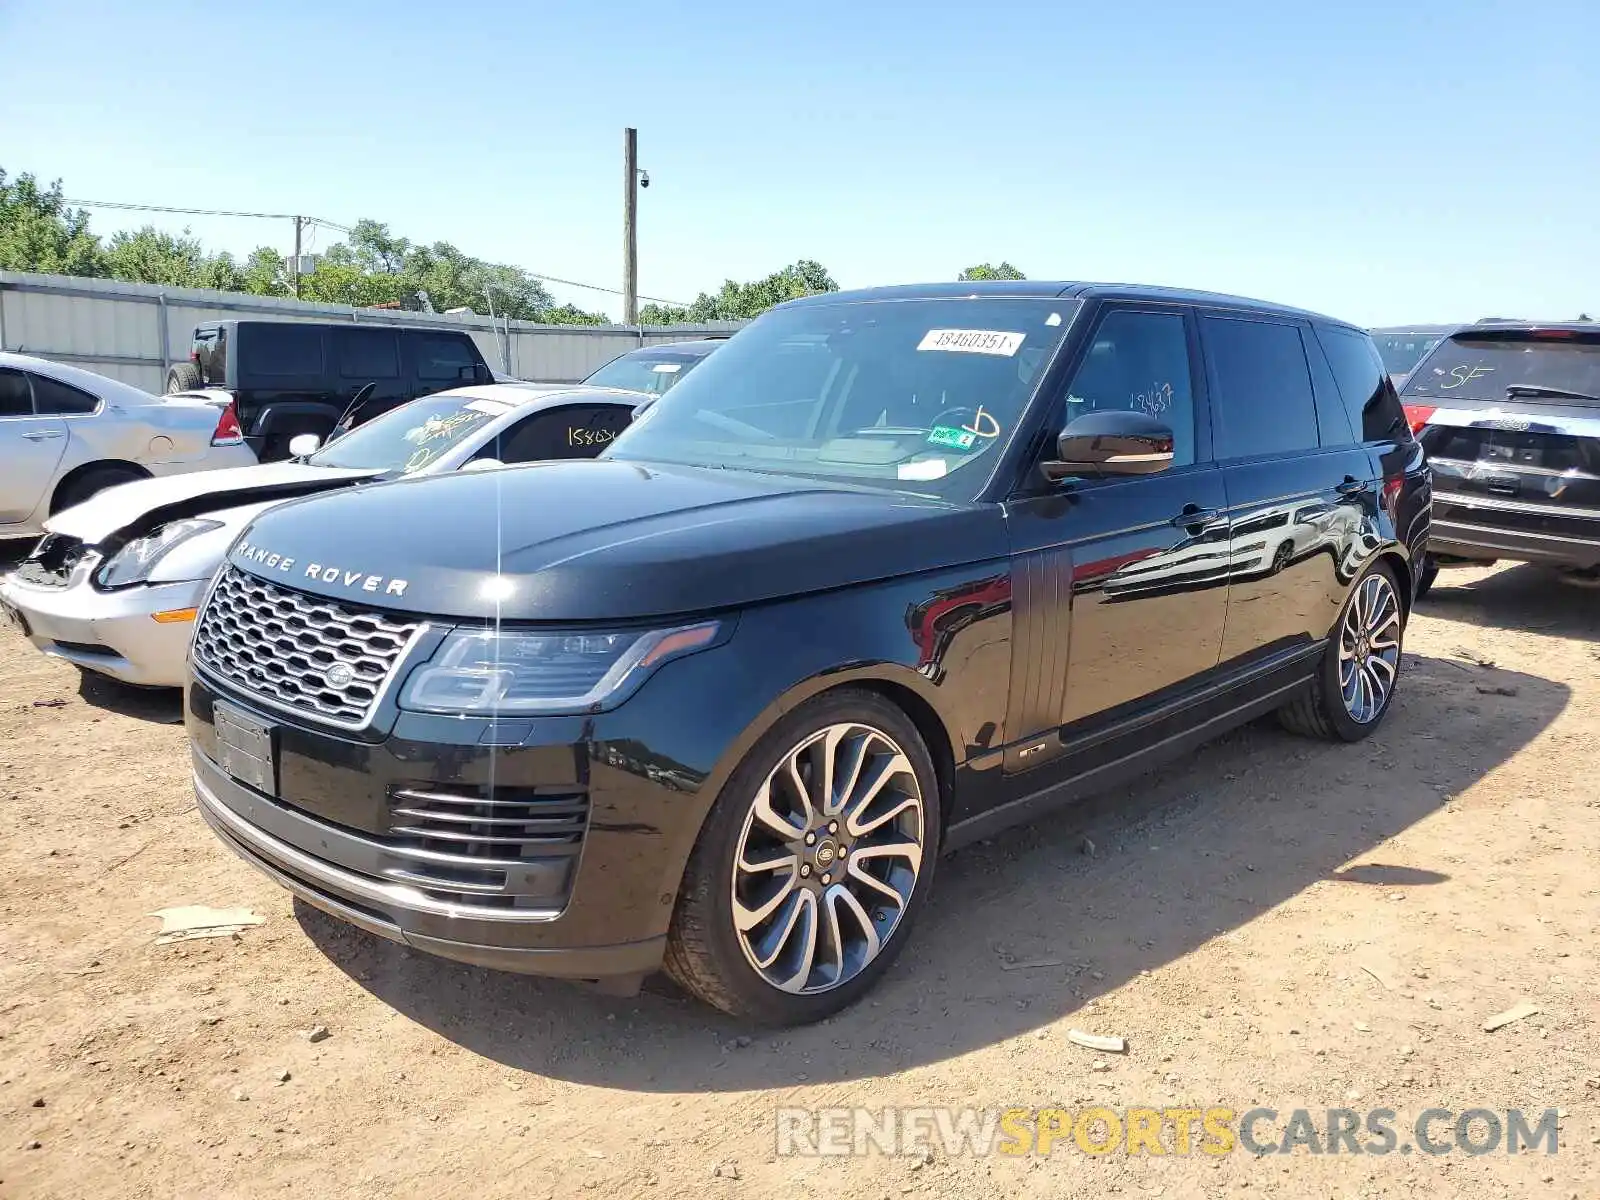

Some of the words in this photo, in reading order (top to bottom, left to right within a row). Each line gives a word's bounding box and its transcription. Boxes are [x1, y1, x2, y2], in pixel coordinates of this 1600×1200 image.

[1440, 365, 1494, 389] SF
[237, 542, 296, 572] RANGE
[304, 563, 408, 596] ROVER
